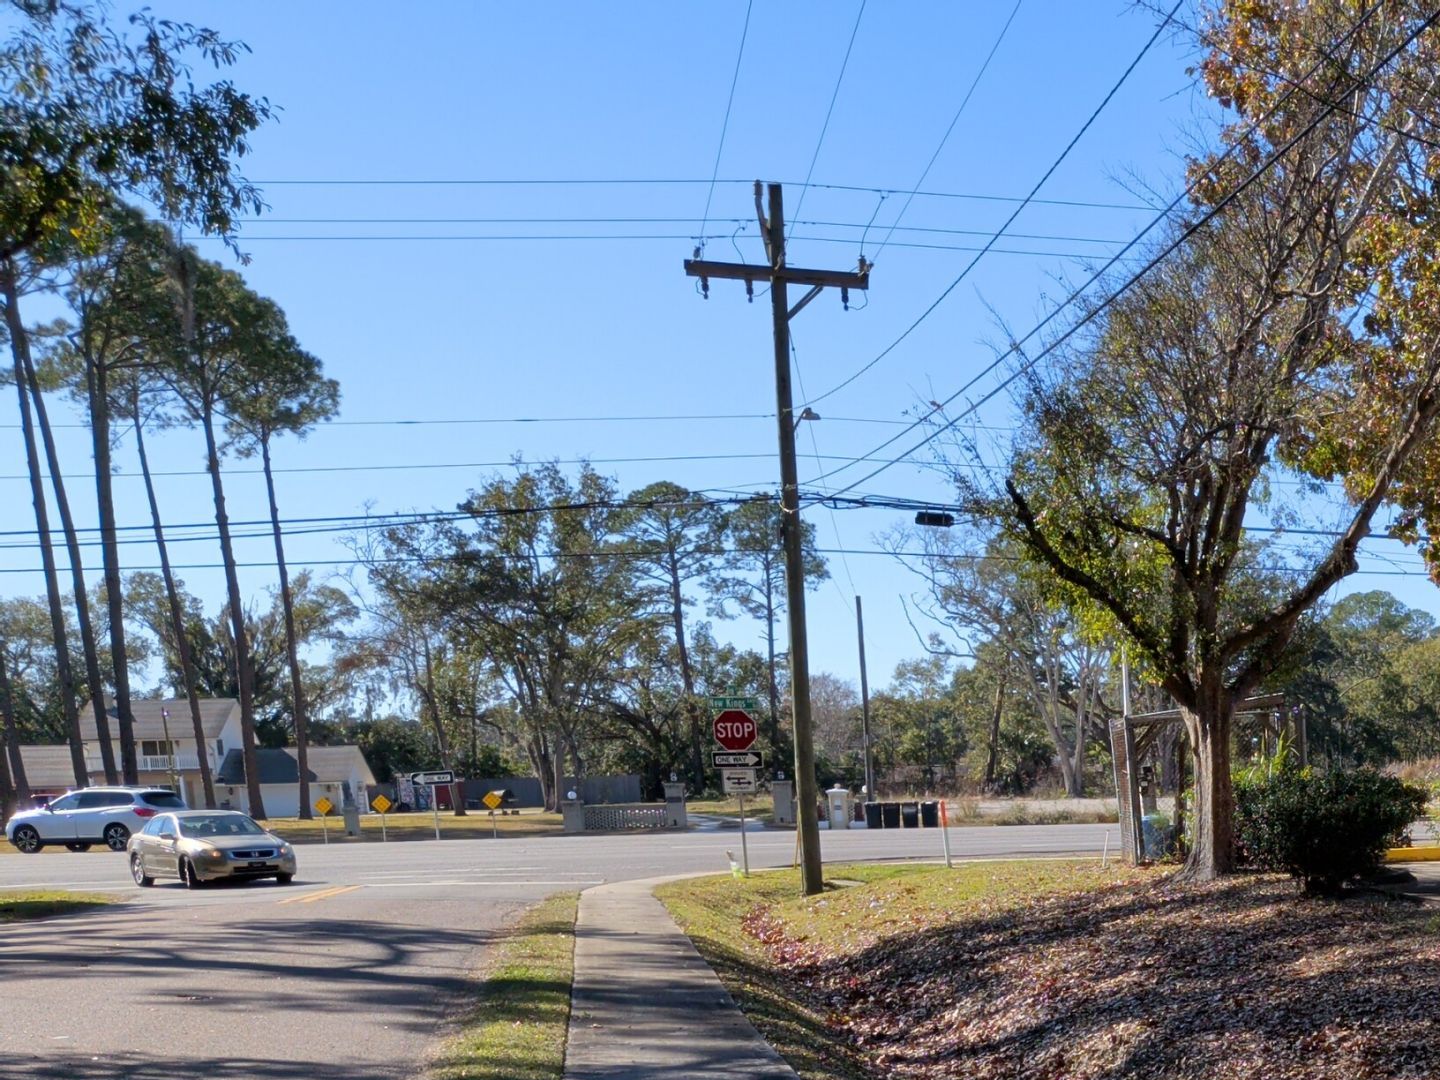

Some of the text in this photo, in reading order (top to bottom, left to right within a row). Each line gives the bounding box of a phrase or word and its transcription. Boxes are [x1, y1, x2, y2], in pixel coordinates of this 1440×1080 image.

[717, 722, 753, 738] STOP
[717, 755, 747, 764] ONE WAY
